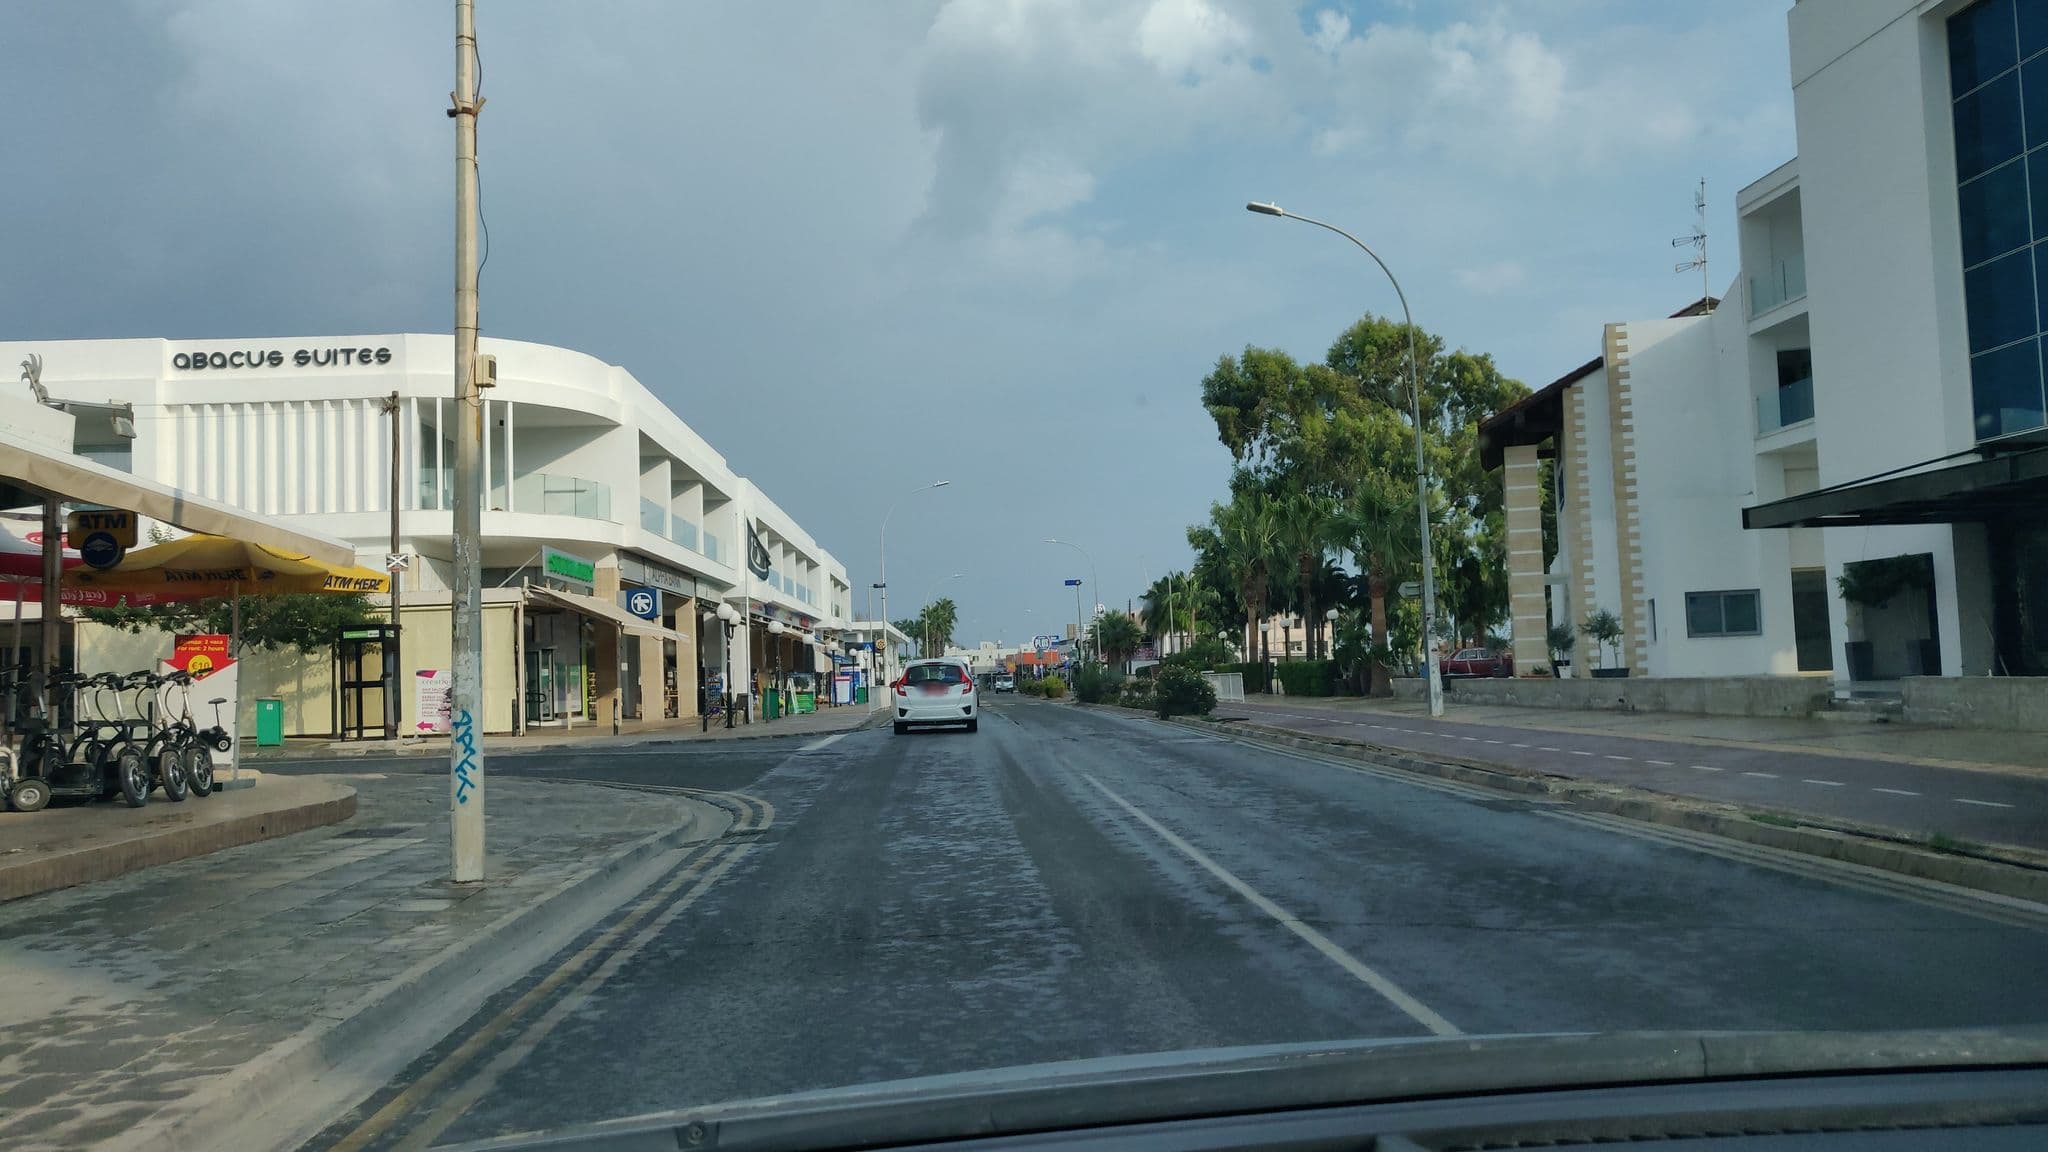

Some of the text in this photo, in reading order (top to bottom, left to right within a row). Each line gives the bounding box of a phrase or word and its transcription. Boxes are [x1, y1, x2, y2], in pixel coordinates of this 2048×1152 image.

[173, 347, 392, 370] ABACUS SUITES
[79, 513, 127, 529] ATM
[164, 569, 248, 582] ATM HERE
[323, 574, 383, 591] ATM HERE
